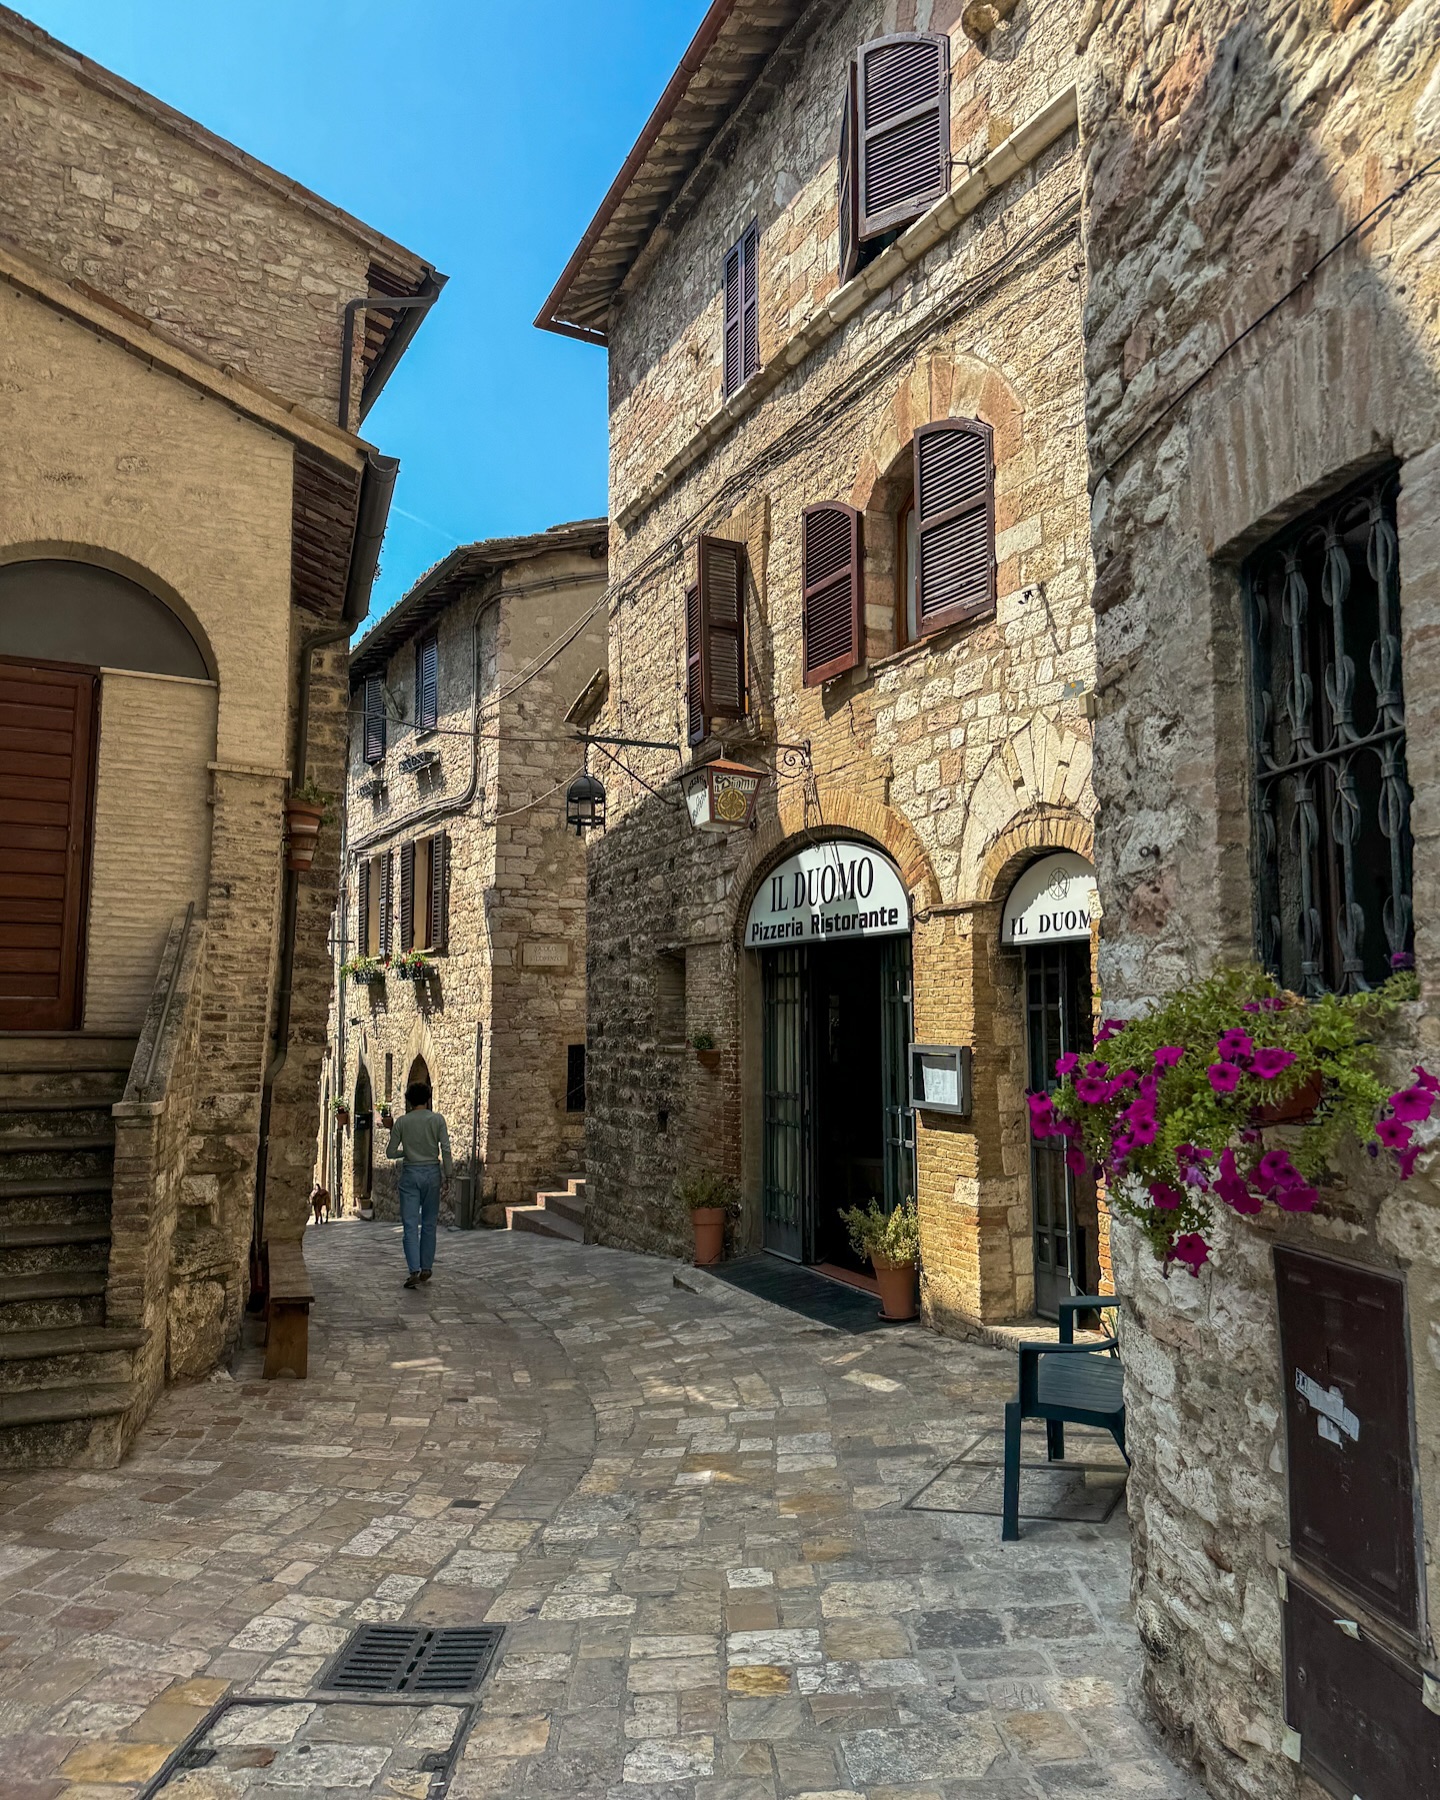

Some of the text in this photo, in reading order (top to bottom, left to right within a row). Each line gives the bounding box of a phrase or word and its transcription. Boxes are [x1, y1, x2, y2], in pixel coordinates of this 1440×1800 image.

[771, 856, 874, 912] IL DUOMO
[751, 906, 898, 942] Pizzeria Ristorante
[1010, 909, 1092, 936] IL DUOM
